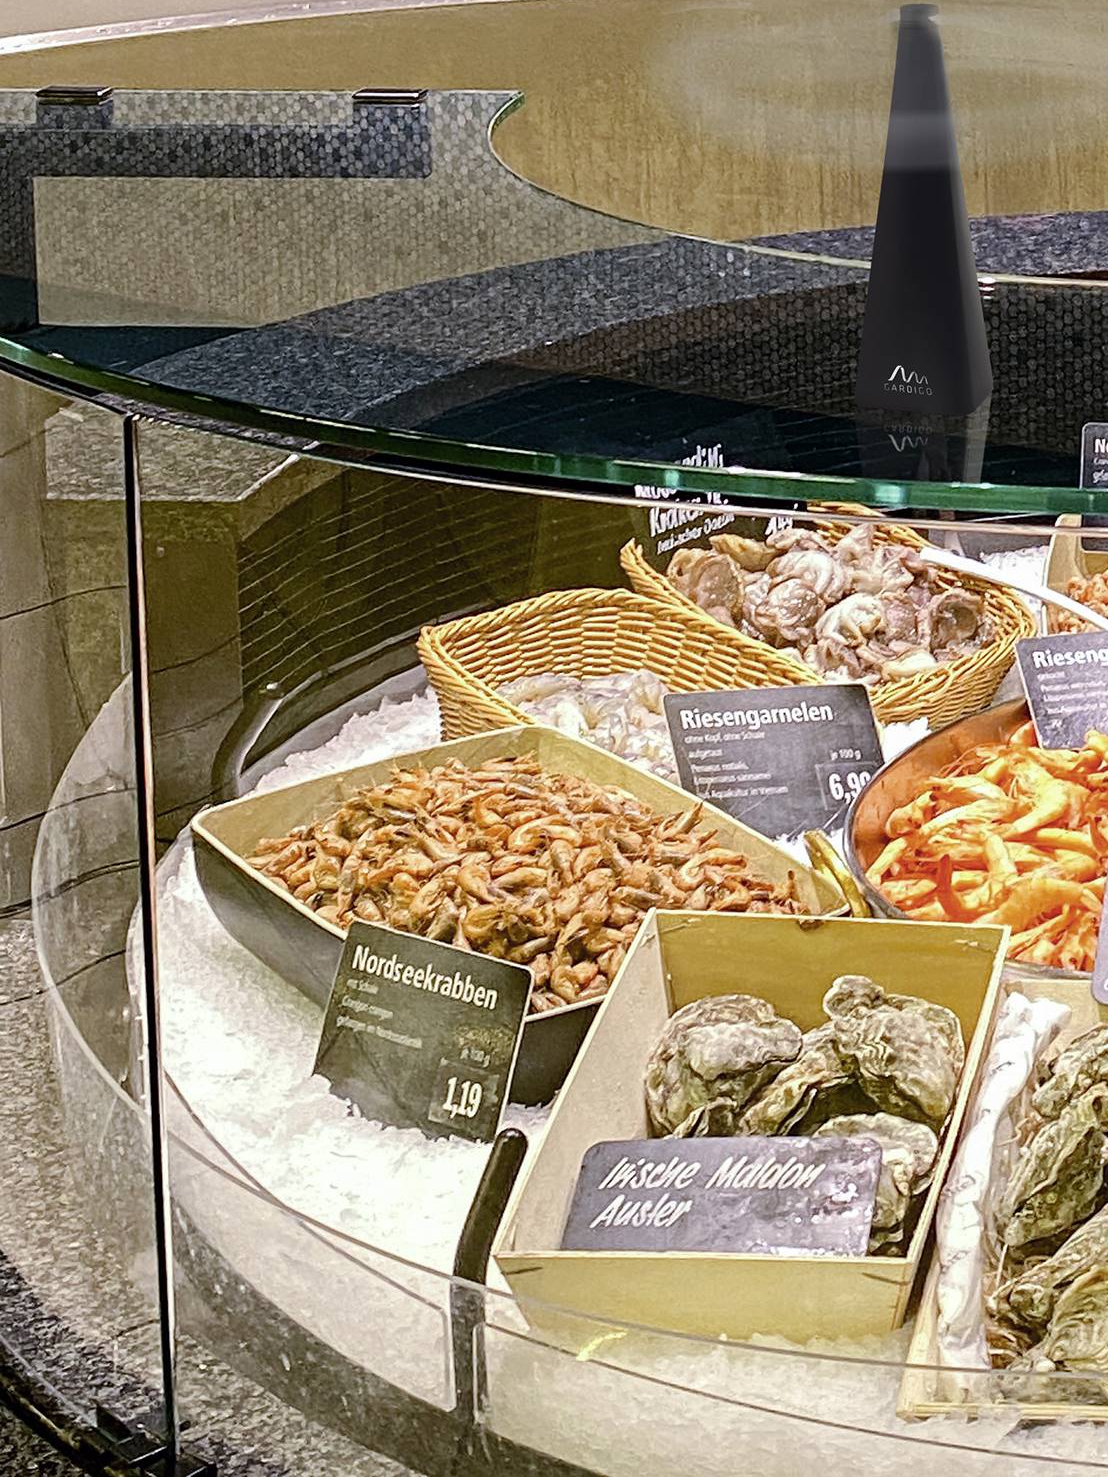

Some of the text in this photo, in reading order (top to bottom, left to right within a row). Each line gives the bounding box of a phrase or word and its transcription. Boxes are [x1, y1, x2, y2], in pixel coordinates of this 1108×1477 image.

[680, 702, 834, 730] Riesengarnelen
[352, 945, 498, 1010] Nordseekrabben
[443, 1076, 483, 1119] 1,19
[599, 1156, 825, 1189] Irische Maldon
[590, 1194, 693, 1228] Auster
